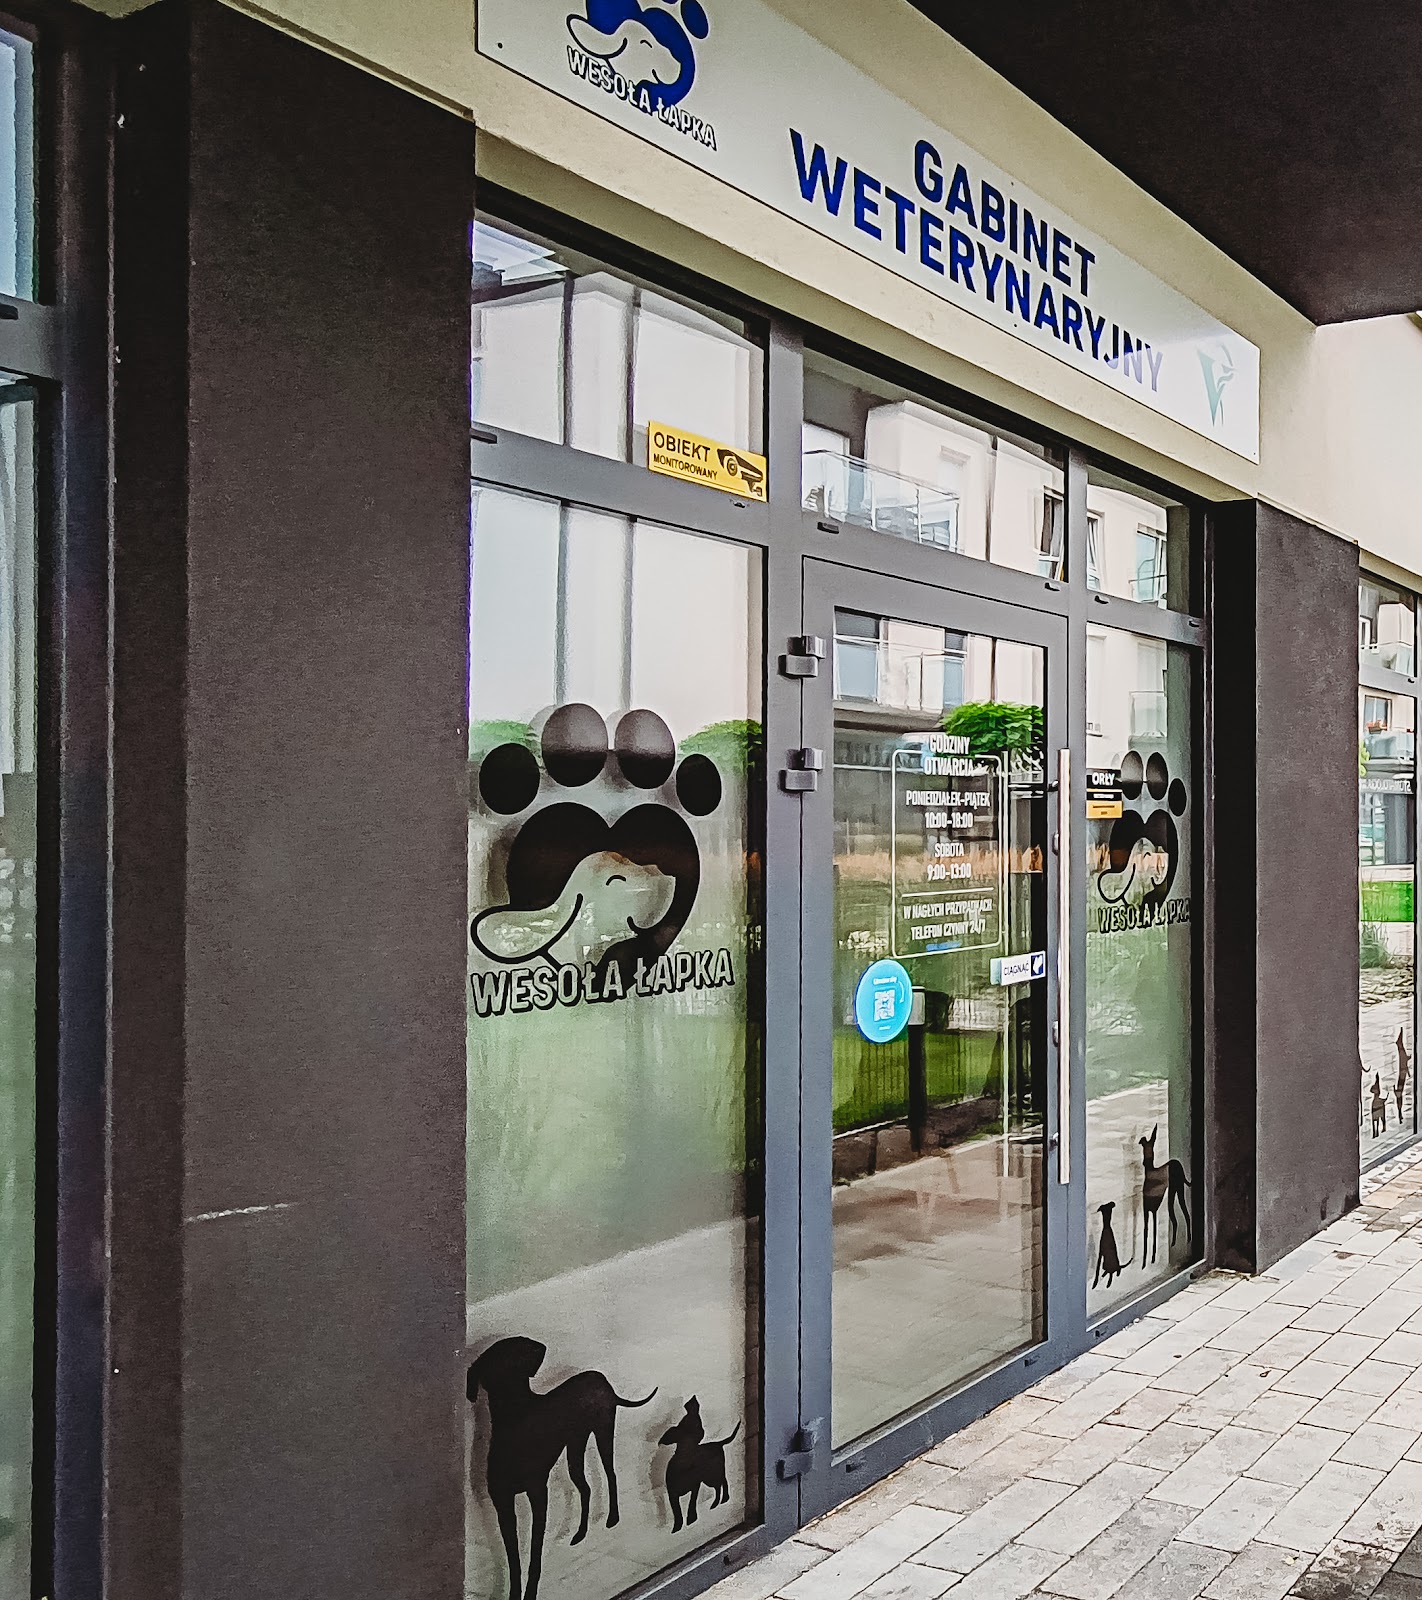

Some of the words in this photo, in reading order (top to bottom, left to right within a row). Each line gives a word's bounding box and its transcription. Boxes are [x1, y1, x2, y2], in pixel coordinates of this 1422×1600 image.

[567, 45, 653, 116] WESOŁA
[656, 97, 718, 151] ŁAPKA
[915, 139, 1096, 297] GABINET
[789, 127, 1163, 392] WETERYNARYJNY
[653, 431, 711, 463] OBIEKT
[653, 453, 718, 481] MONITOROWANY
[929, 734, 970, 754] GODZINY
[924, 757, 975, 777] OTWARCIA
[1092, 772, 1115, 786] ORŁY
[905, 790, 990, 810] PONIEDZIAŁEK-PIĄTEK
[925, 812, 974, 829] 10:00-18:00
[934, 842, 965, 858] SOBOTA
[926, 862, 972, 881] 9:00-13:00
[903, 905, 911, 920] W
[912, 901, 945, 918] NAGŁYCH
[1098, 903, 1151, 934] WESOŁA
[911, 924, 942, 941] TELEFON
[943, 921, 969, 937] CZYNNY
[470, 959, 628, 1018] WESOŁA
[632, 948, 736, 998] ŁAPKA
